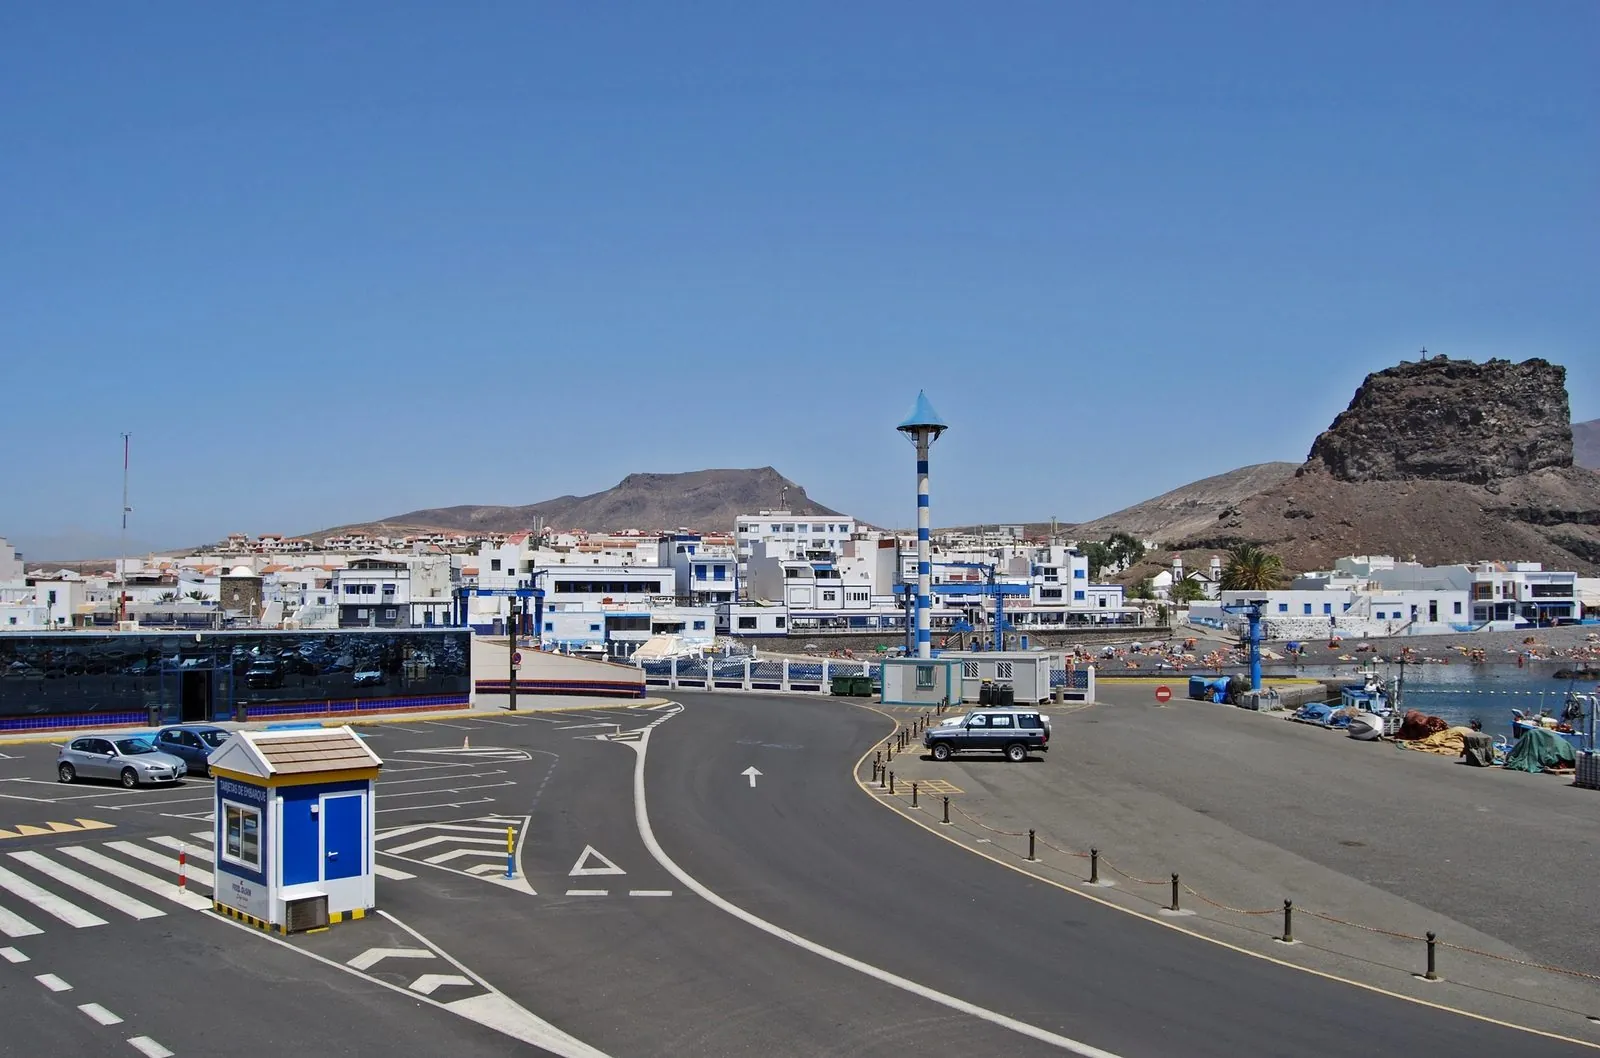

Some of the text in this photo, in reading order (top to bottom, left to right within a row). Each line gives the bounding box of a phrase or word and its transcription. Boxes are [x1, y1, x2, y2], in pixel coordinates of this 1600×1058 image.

[220, 780, 266, 802] TARJETAS DE EMBARQUE
